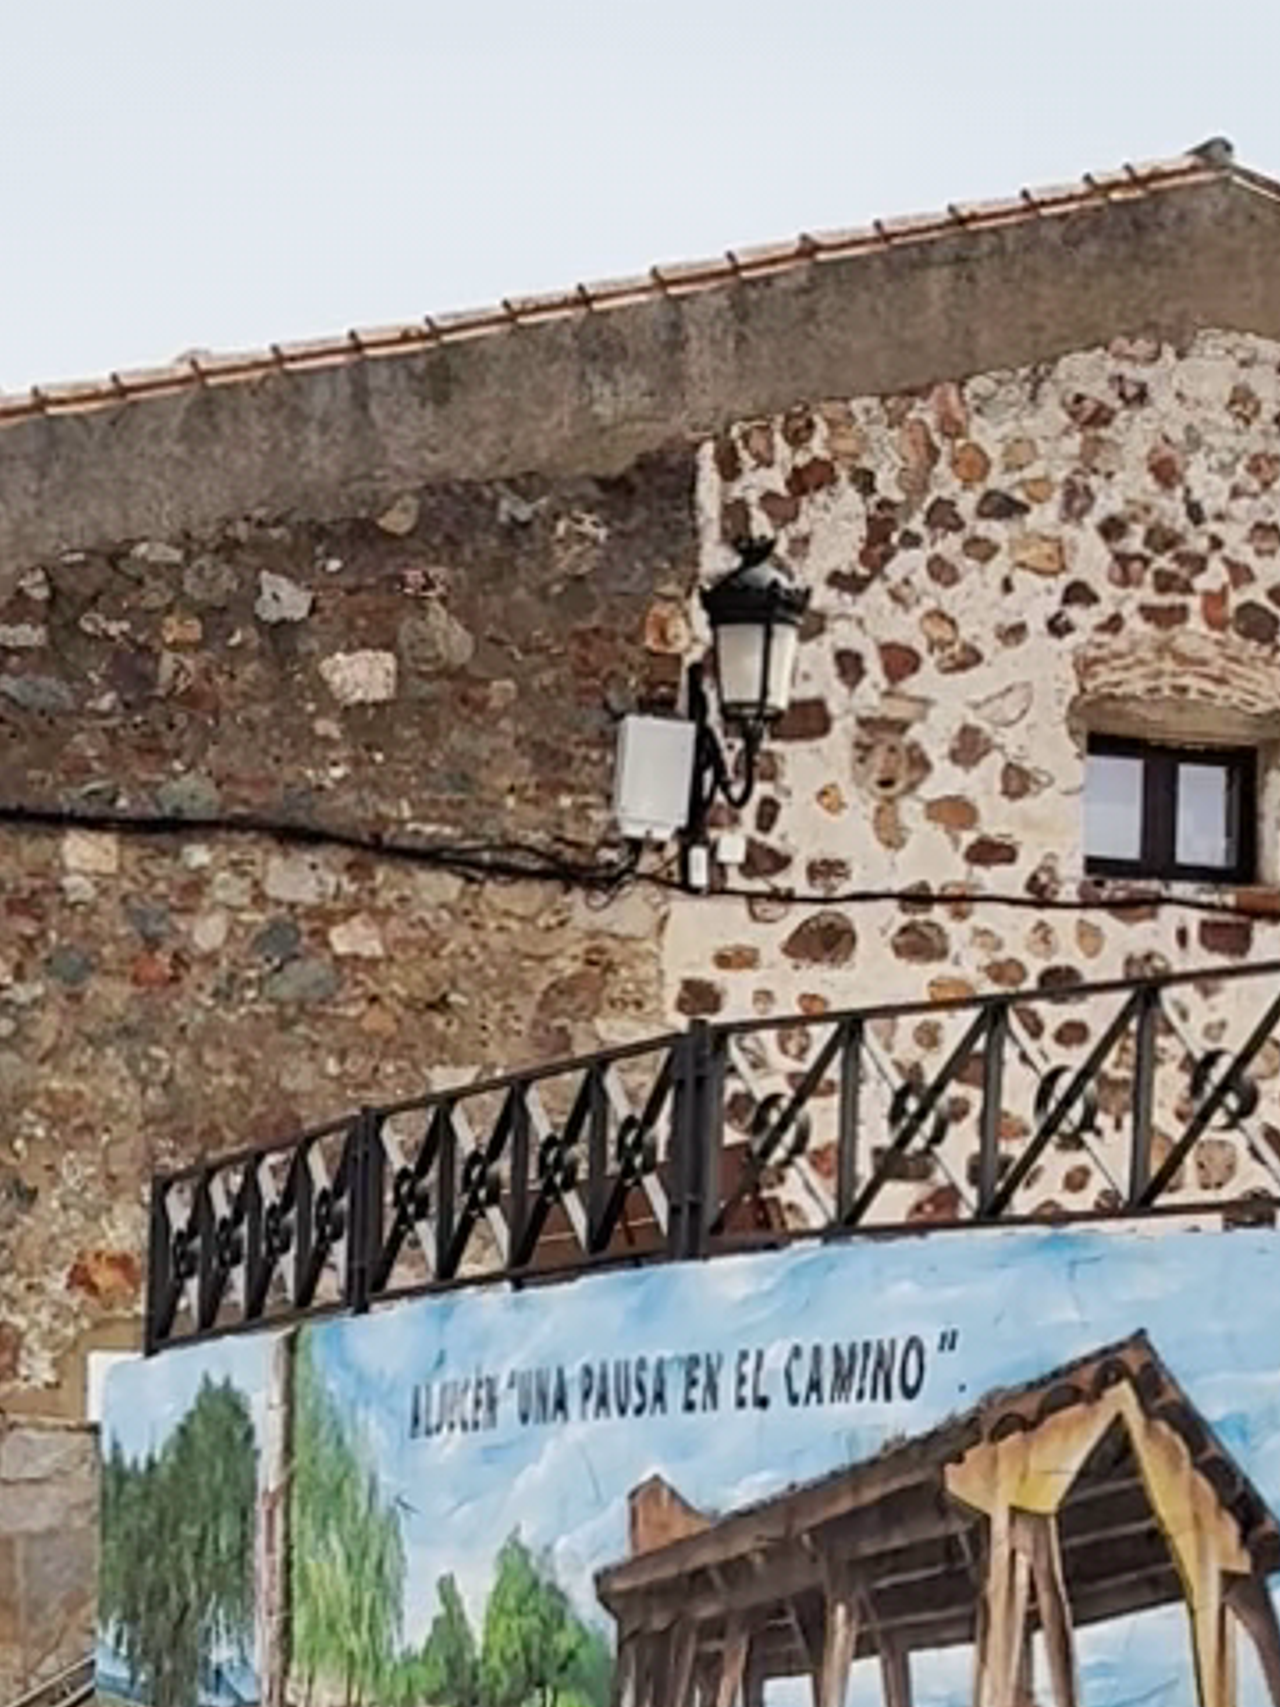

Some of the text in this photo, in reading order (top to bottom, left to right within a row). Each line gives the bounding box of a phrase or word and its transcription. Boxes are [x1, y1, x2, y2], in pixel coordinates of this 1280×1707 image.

[580, 1354, 667, 1419] PAUSA
[681, 1351, 723, 1412] EN
[734, 1348, 770, 1410] EL
